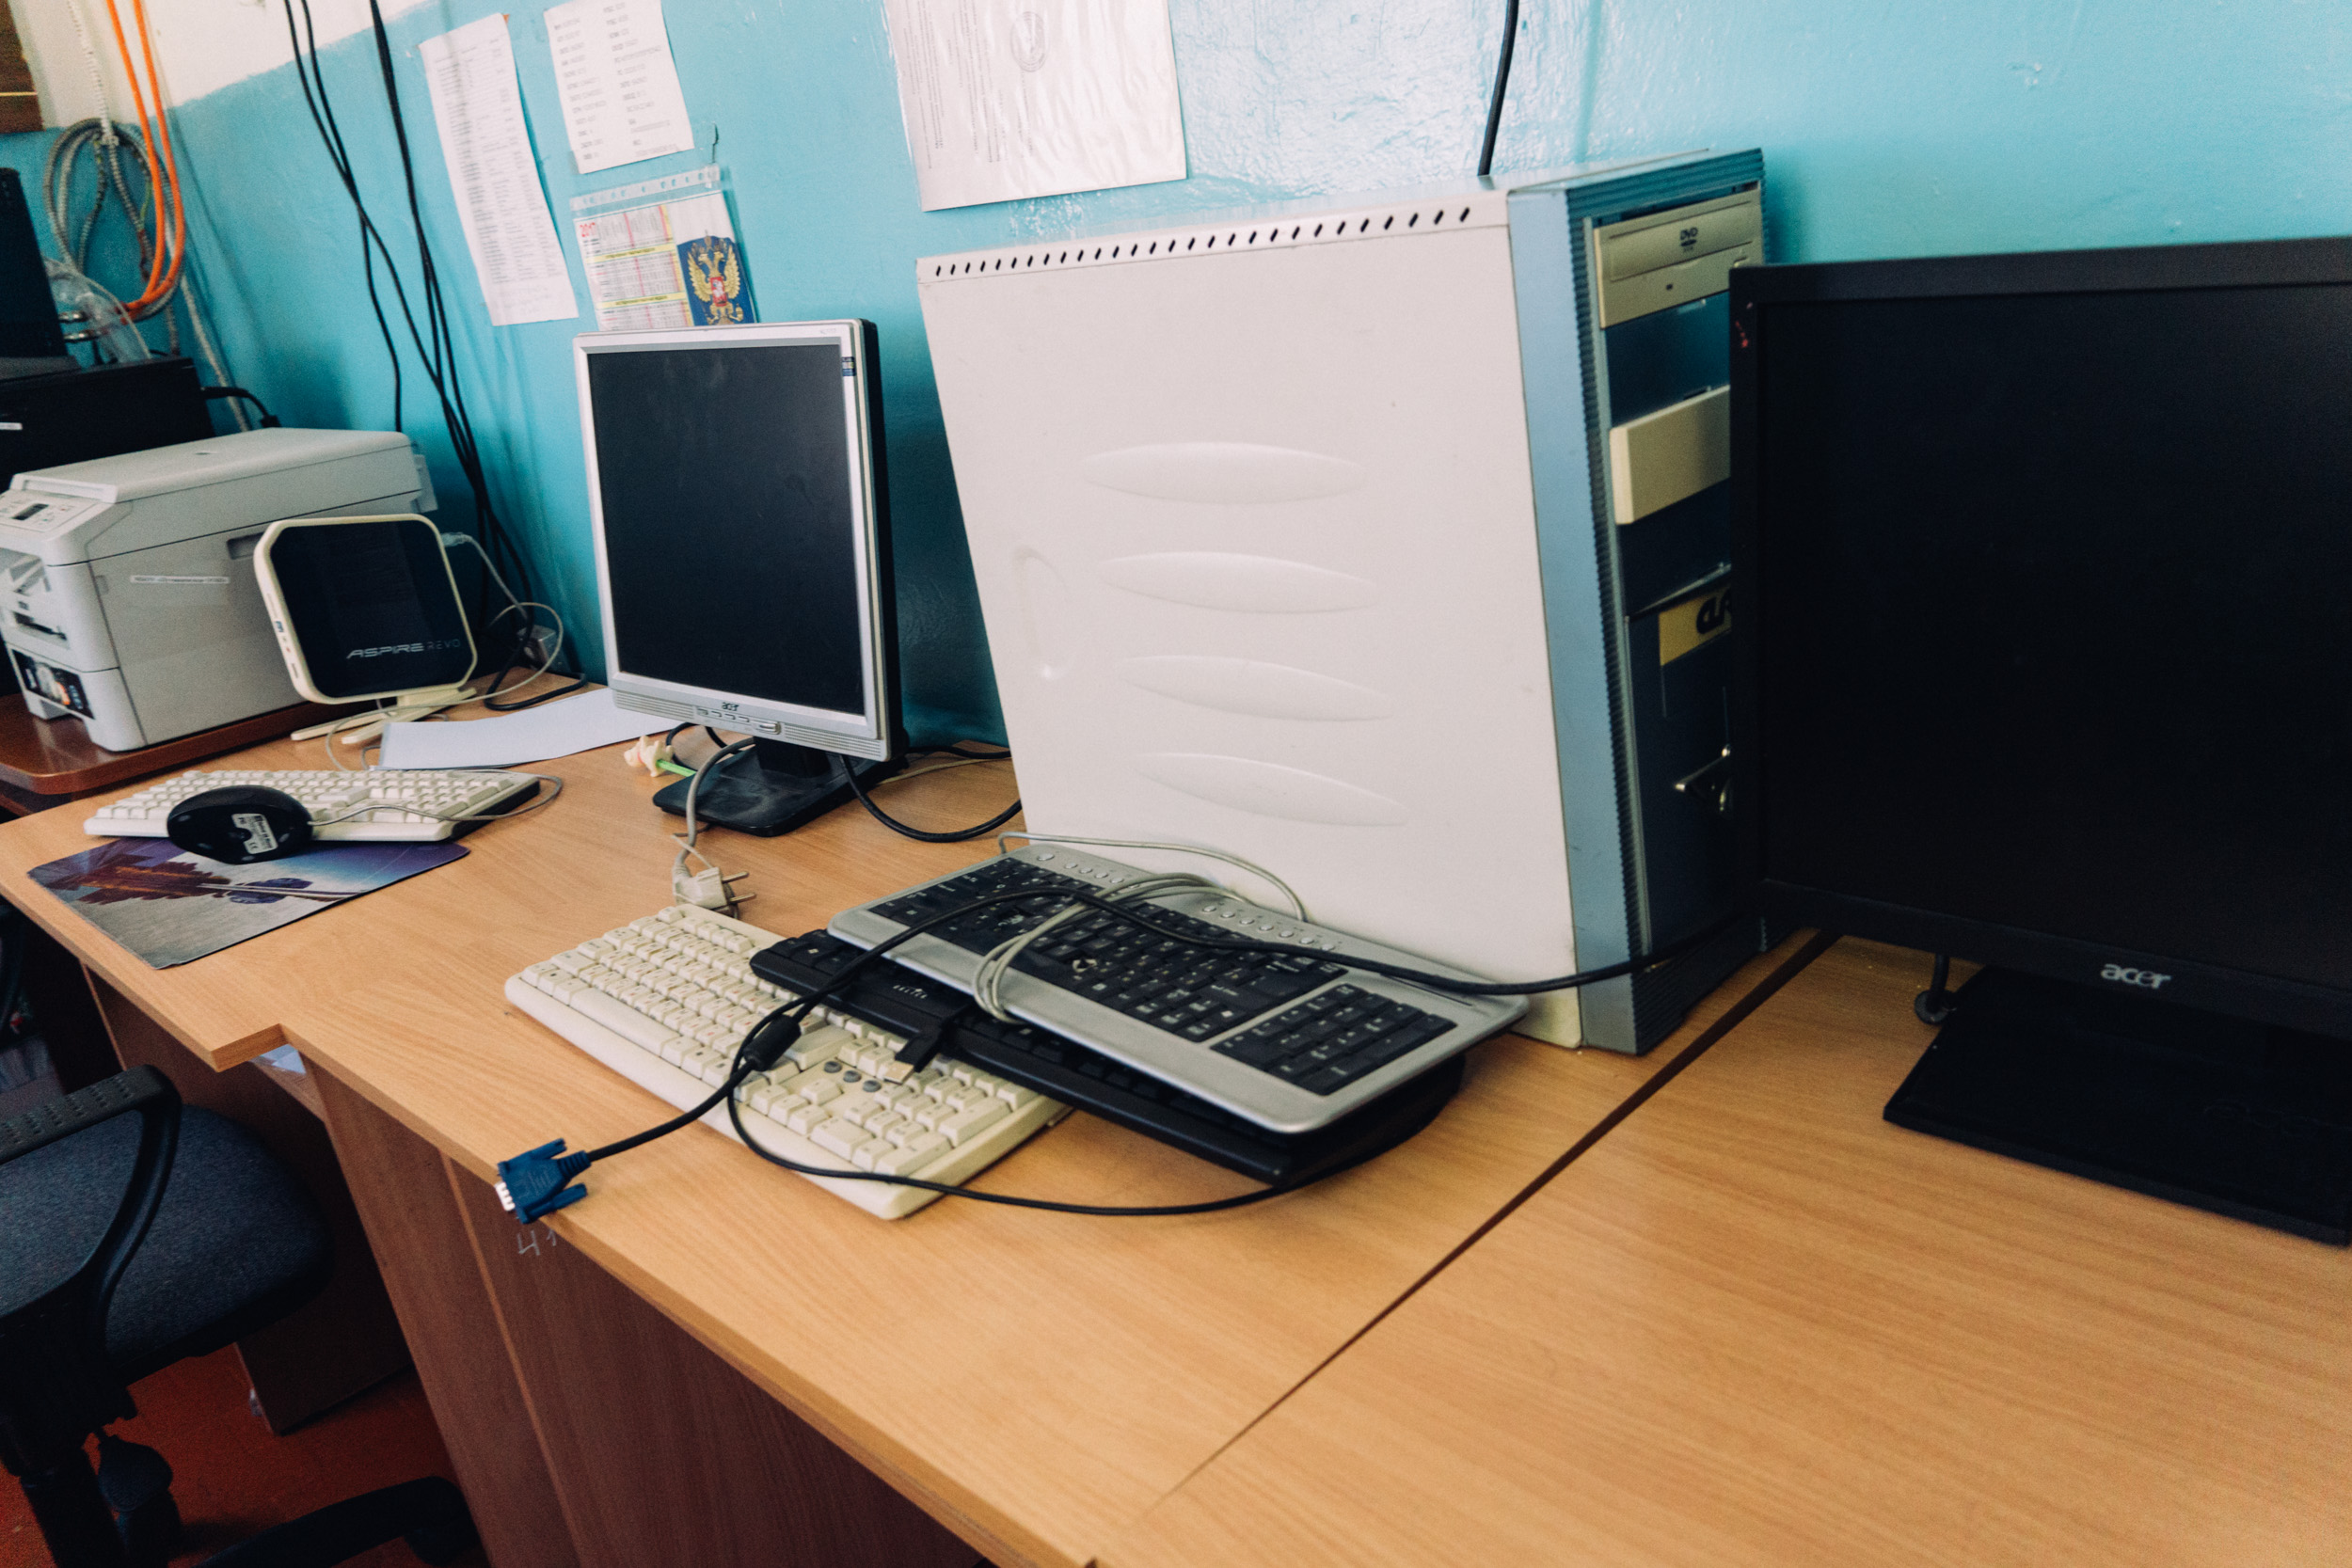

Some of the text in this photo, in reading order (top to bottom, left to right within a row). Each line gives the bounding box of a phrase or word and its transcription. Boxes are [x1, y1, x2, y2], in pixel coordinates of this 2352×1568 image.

[1680, 227, 1698, 241] DVD
[346, 639, 461, 659] ASPIRE REVO
[2101, 963, 2171, 989] acer
